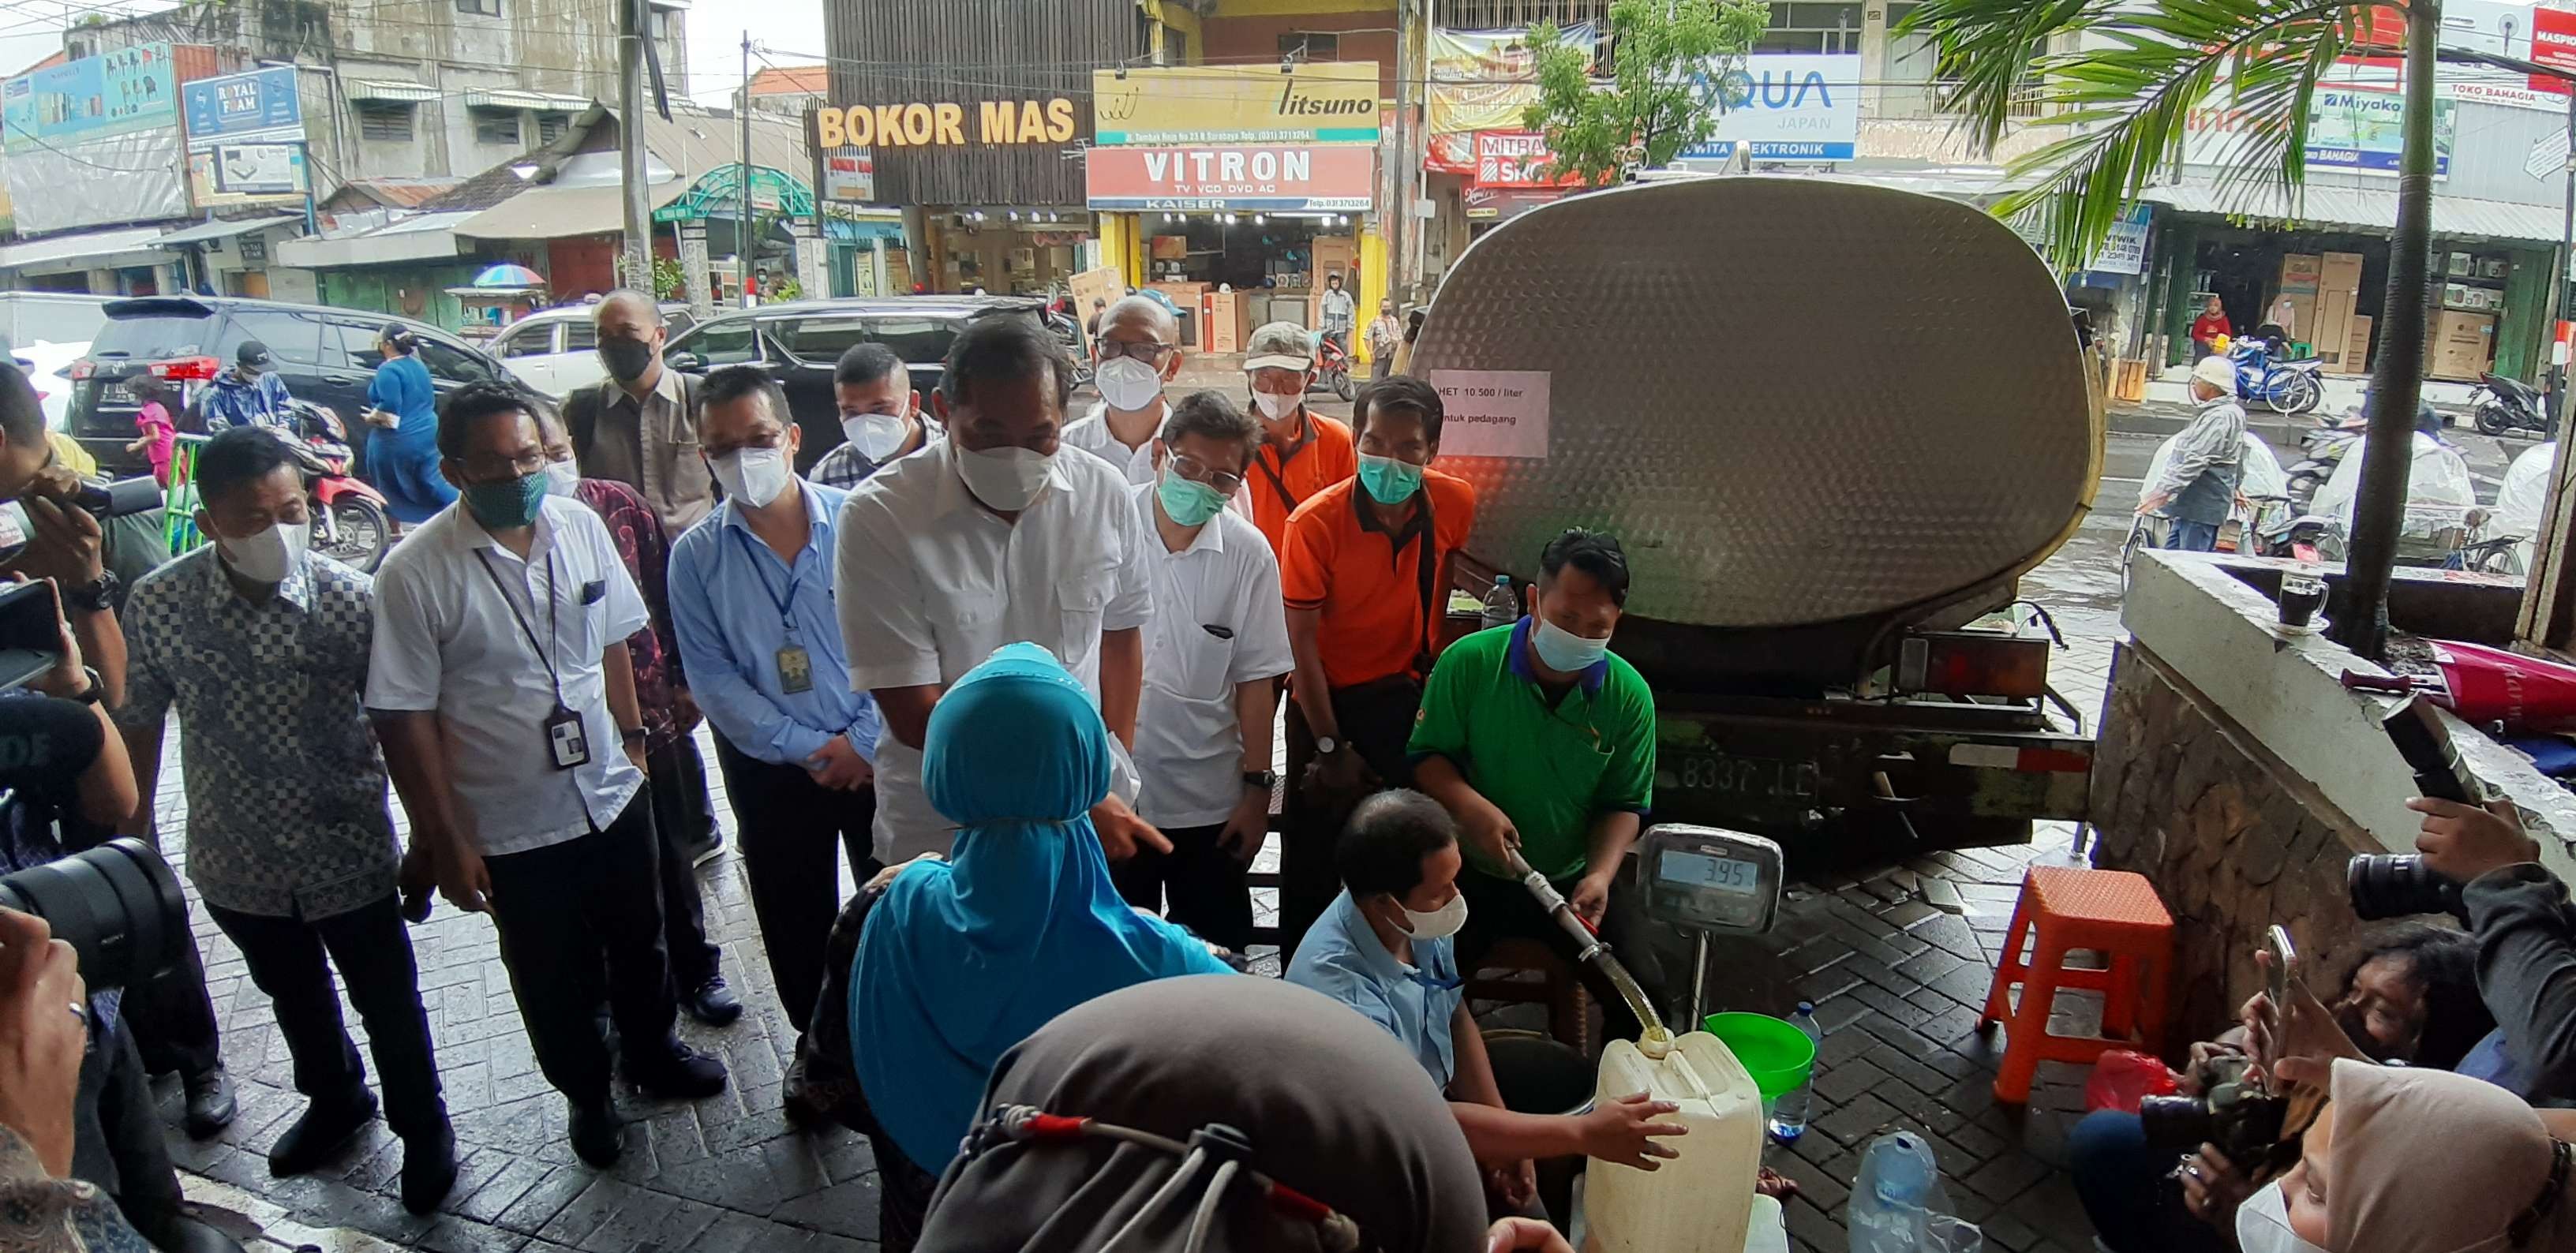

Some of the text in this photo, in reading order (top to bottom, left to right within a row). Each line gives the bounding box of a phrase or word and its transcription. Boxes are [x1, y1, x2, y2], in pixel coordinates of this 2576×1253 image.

[1690, 69, 1833, 109] AQUA
[2451, 84, 2536, 102] TOKO BAHAGIA
[2339, 95, 2401, 112] Miyako
[817, 98, 1075, 148] BOKOR MAS
[1777, 117, 1831, 129] JAPAN
[1482, 137, 1545, 154] MITRA
[1143, 151, 1309, 181] VITRON
[1174, 185, 1276, 193] TV VCD DVD AC
[1145, 199, 1226, 210] KAISER
[1439, 387, 1458, 396] HET
[1464, 387, 1476, 397] 10
[1478, 387, 1496, 397] 500
[1503, 387, 1523, 398] liter
[1467, 414, 1517, 426] pedagang
